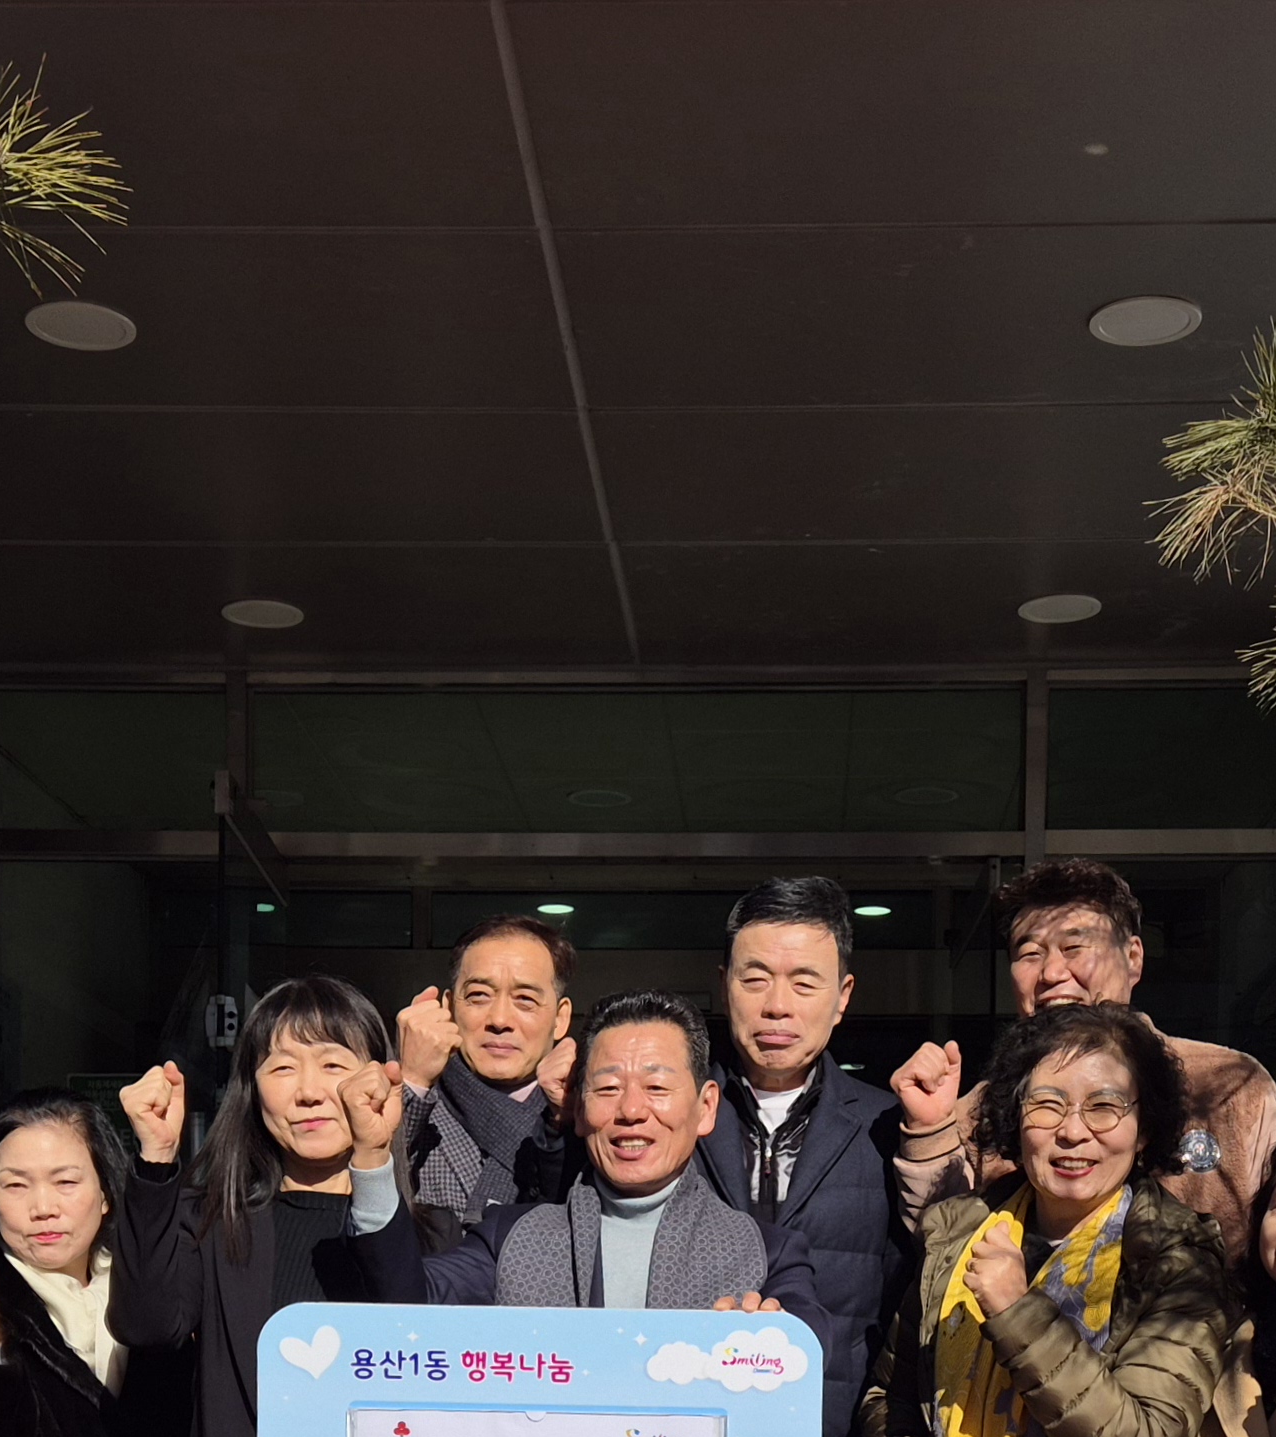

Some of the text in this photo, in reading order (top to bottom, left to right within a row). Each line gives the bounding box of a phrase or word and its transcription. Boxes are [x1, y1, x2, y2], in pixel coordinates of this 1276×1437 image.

[350, 1348, 575, 1384] 용산1동 행복나눔
[721, 1347, 785, 1375] Smiling
